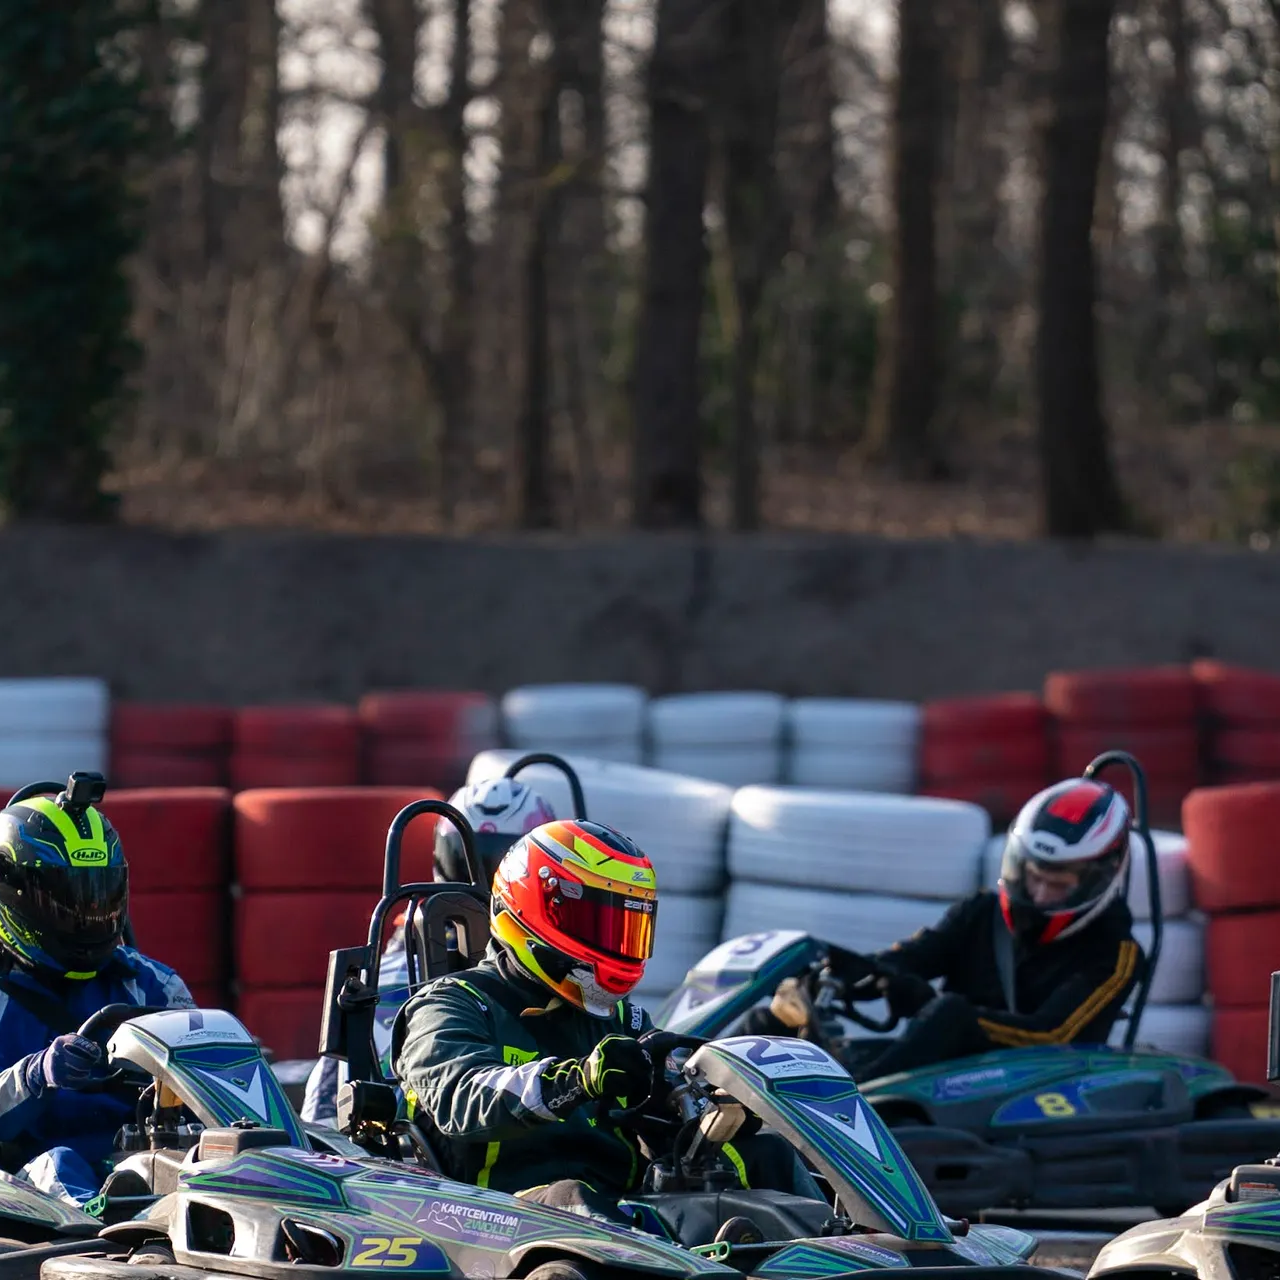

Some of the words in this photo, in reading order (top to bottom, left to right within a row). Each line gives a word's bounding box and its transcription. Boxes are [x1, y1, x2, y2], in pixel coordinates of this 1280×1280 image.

[722, 1036, 829, 1066] 25
[1035, 1092, 1076, 1117] 8
[440, 1202, 519, 1227] KARTCENTRUM
[464, 1219, 516, 1236] ZWOLLE
[351, 1237, 423, 1267] 25
